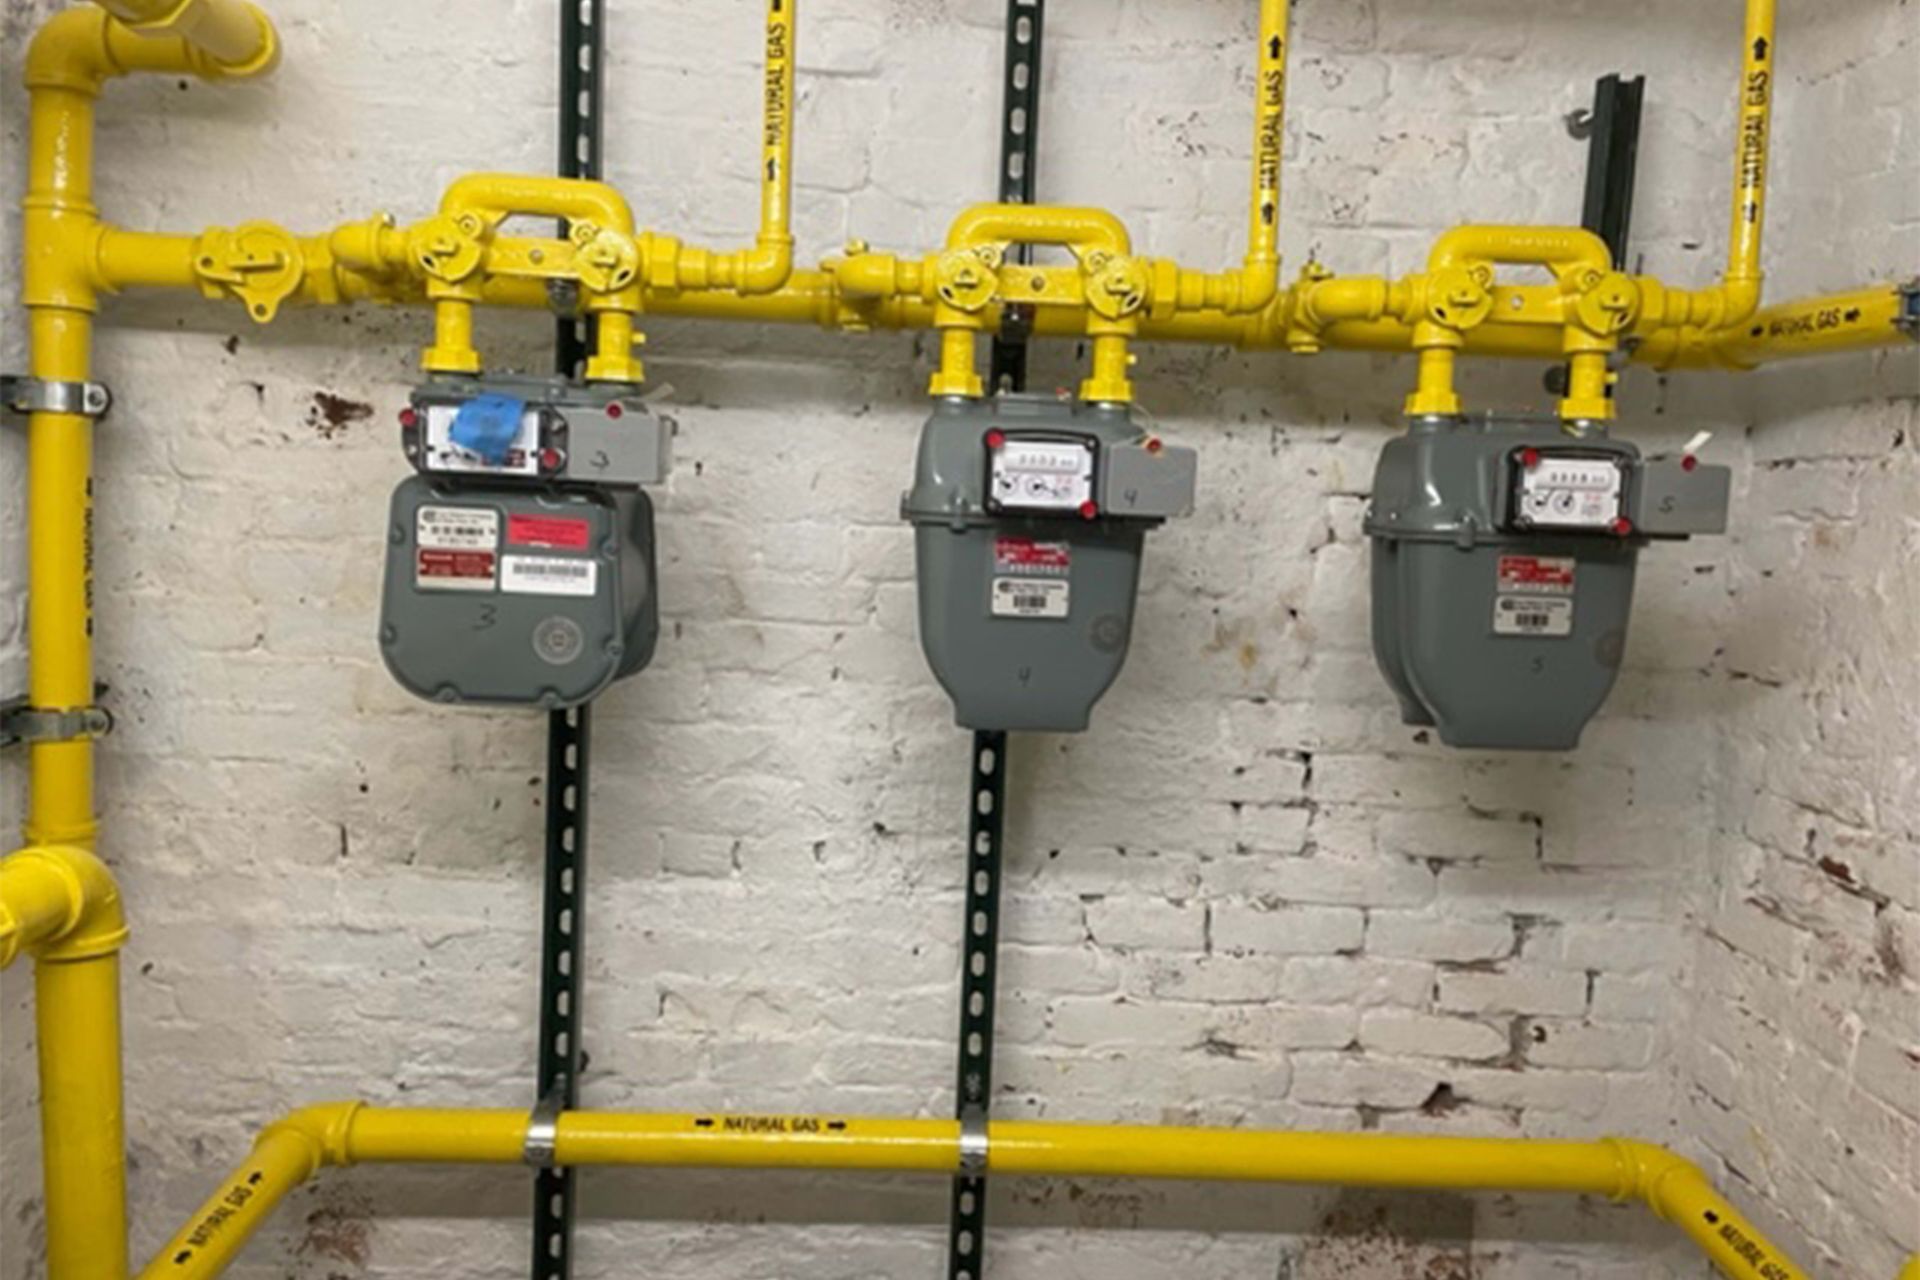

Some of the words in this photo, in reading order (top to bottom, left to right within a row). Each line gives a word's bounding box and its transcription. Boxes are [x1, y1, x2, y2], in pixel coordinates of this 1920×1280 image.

[767, 22, 786, 59] GAS
[766, 65, 784, 146] NATURAL
[1264, 70, 1283, 106] GAS
[1747, 70, 1768, 106] GAS
[1260, 113, 1282, 190] NATURAL
[1741, 113, 1764, 188] NATURAL
[1817, 307, 1841, 330] GAS
[1123, 488, 1137, 508] 4
[472, 604, 497, 630] 3
[723, 1116, 787, 1132] NATURAL
[790, 1117, 820, 1133] GAS
[186, 1206, 236, 1248] NATURAL
[224, 1185, 253, 1208] GAS
[1717, 1223, 1766, 1269] NATURAL
